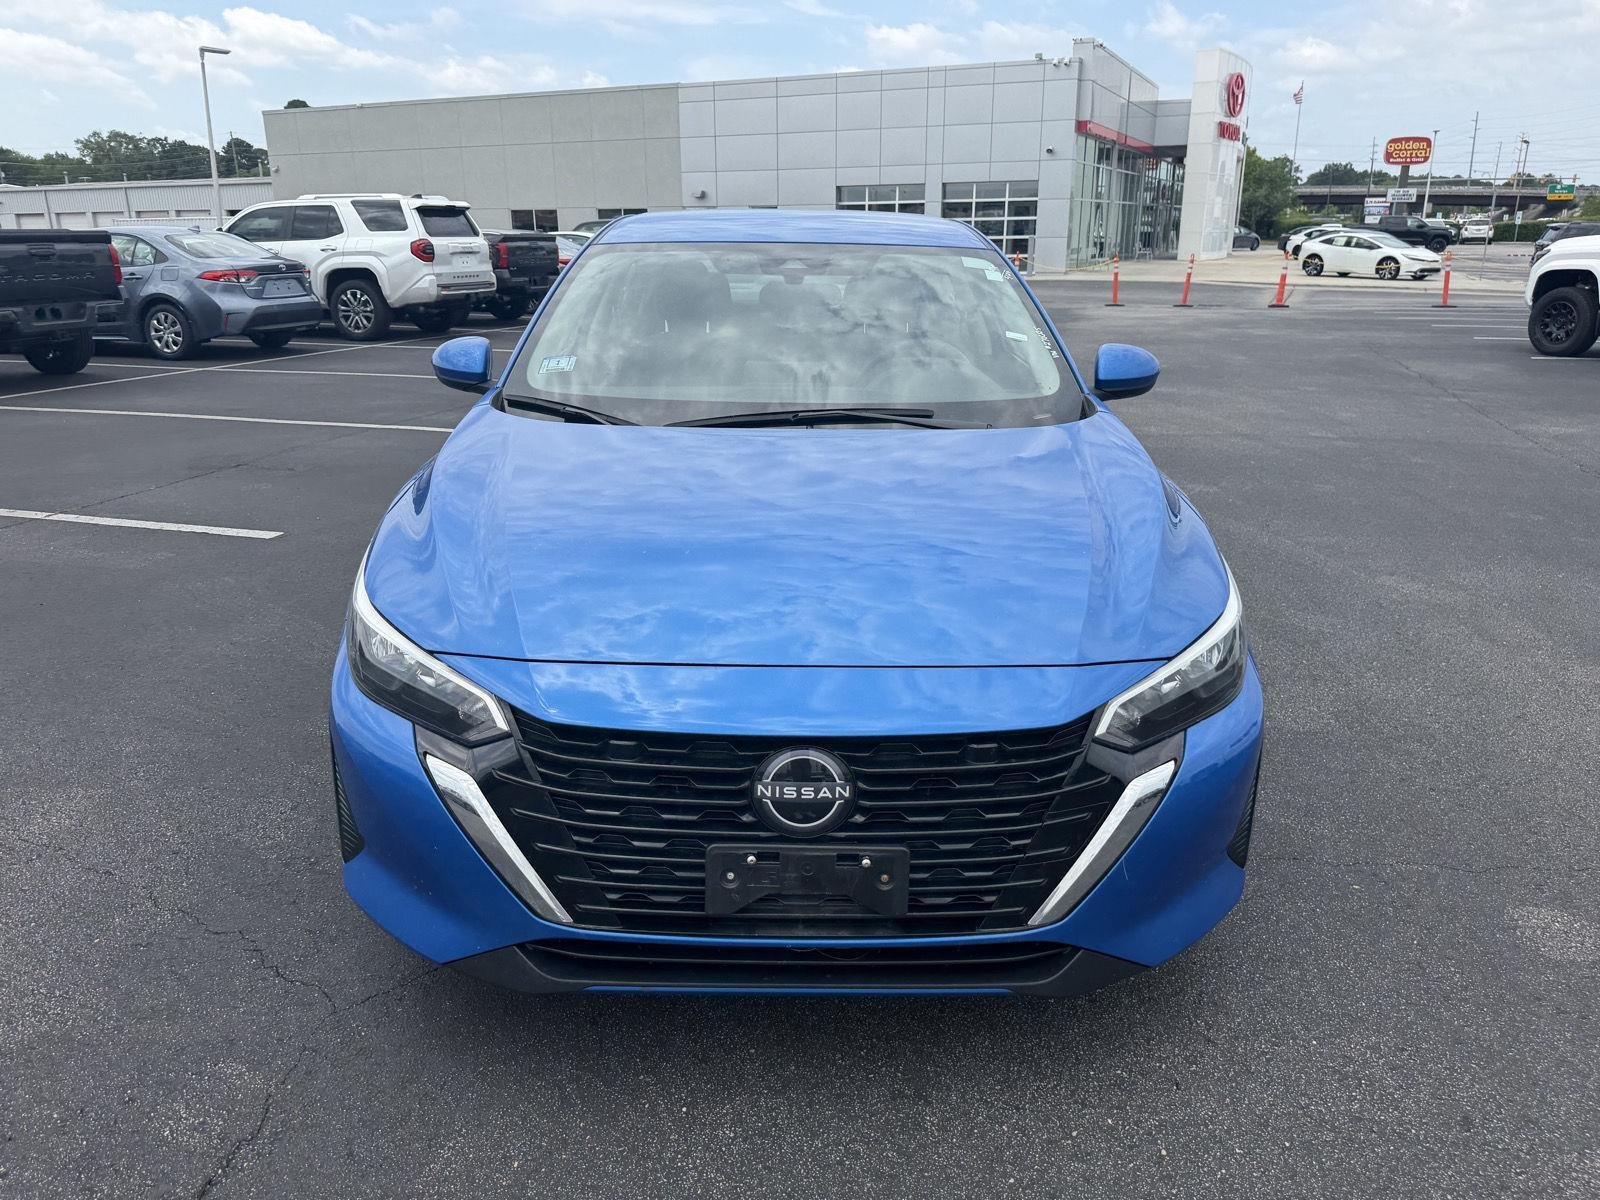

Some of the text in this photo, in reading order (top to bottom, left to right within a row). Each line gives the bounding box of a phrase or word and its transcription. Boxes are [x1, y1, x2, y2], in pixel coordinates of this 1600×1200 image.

[1219, 121, 1240, 141] TOYOTA
[1387, 141, 1427, 152] golden
[1392, 148, 1430, 157] corral
[757, 784, 850, 799] NISSAN
